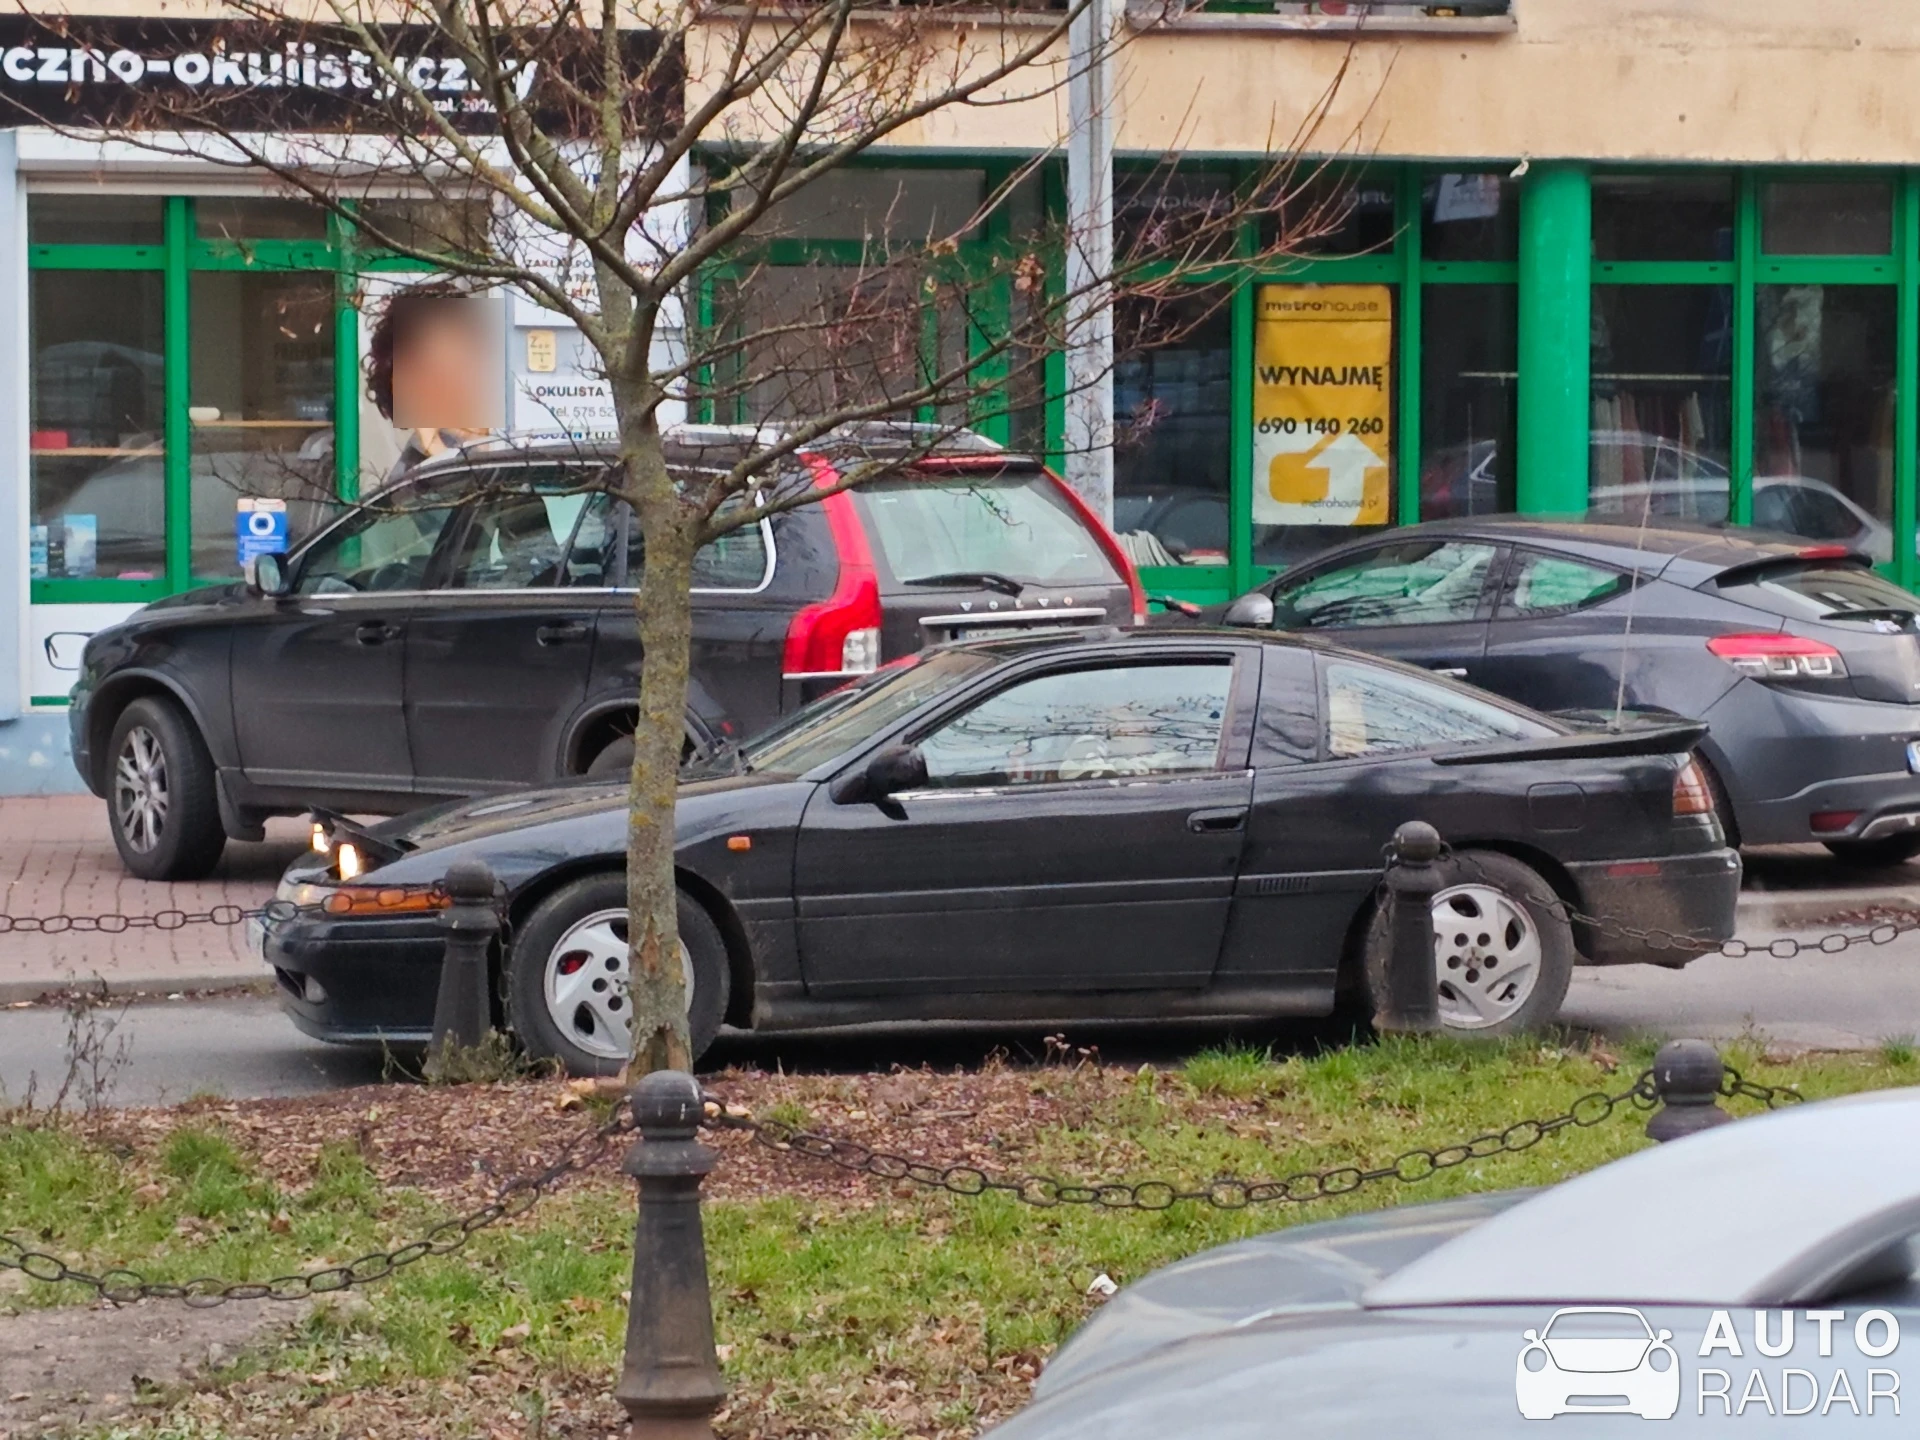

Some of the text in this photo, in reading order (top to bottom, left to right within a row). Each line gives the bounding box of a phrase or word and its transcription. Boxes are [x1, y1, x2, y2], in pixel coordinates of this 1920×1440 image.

[0, 42, 538, 101] czno-okulistyczy
[1265, 300, 1378, 312] metrohouse
[1259, 366, 1383, 392] WYNAJMĘ
[536, 385, 604, 397] OKULISTA
[574, 407, 595, 418] 575
[1258, 417, 1384, 435] 690 140 260
[960, 596, 1073, 611] VOLVO
